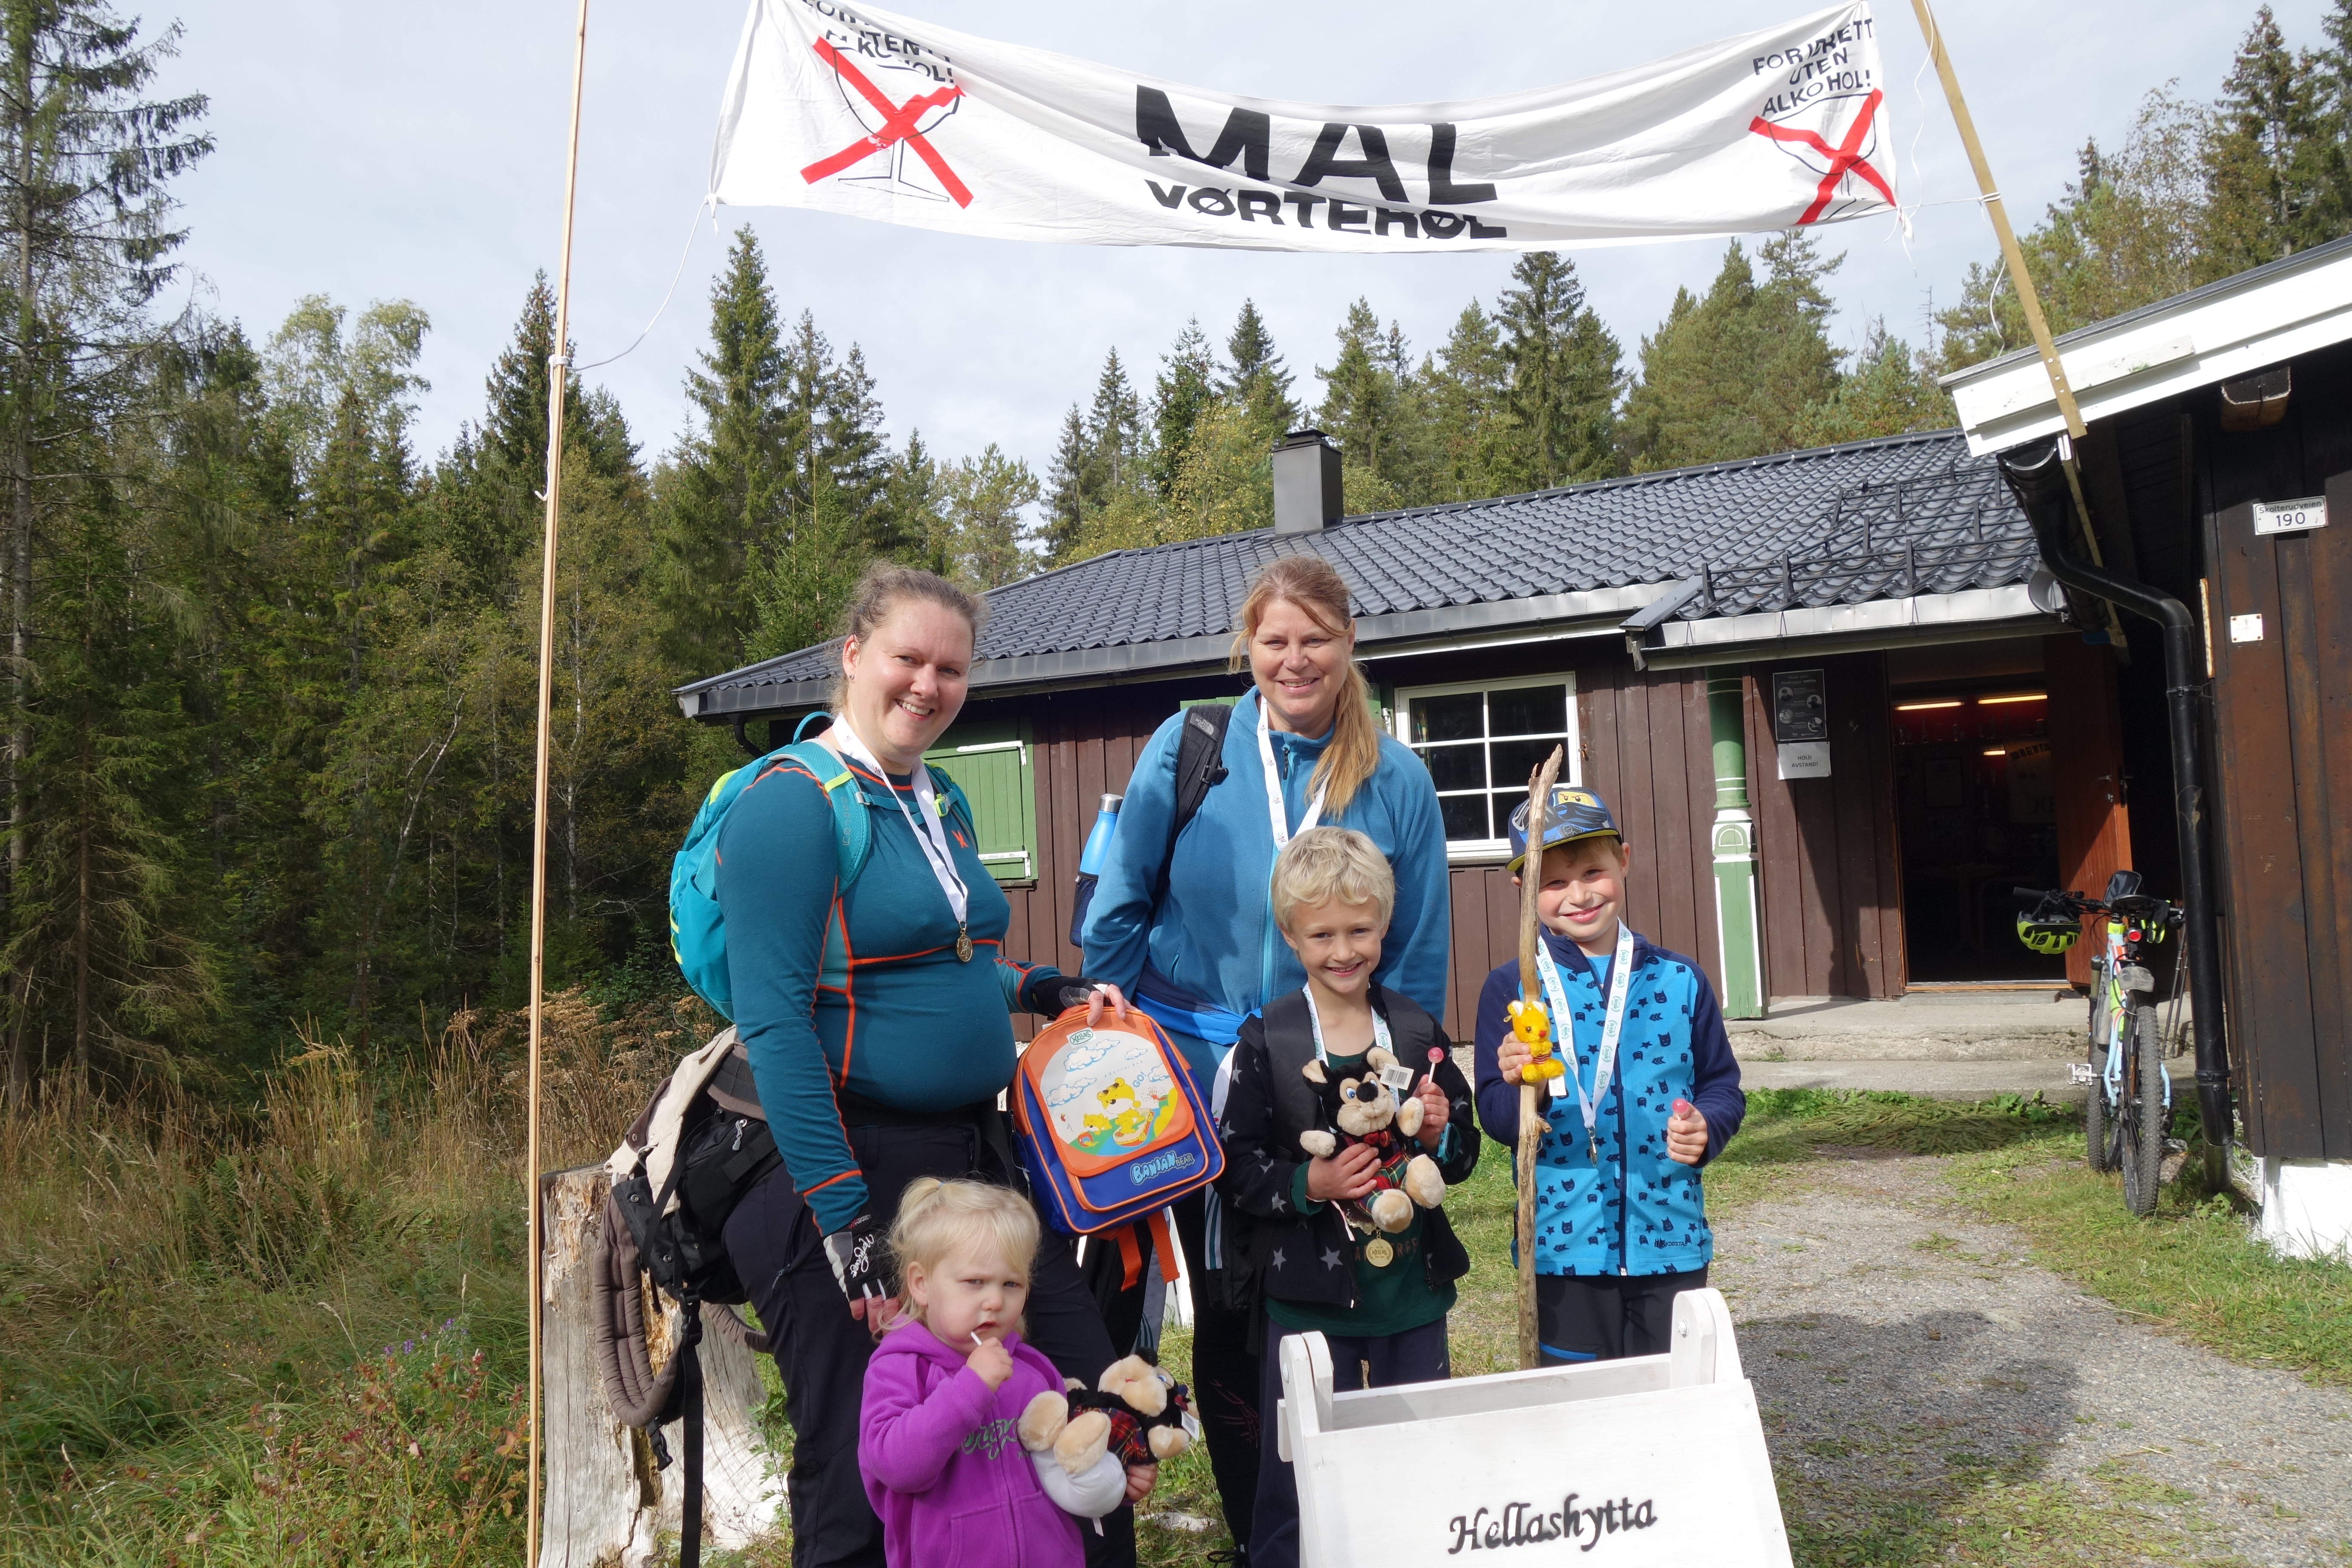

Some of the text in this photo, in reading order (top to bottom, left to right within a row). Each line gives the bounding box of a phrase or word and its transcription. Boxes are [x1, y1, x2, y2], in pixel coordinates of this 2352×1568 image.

[1753, 48, 1803, 75] FOR
[1789, 47, 1848, 85] UTEN
[1761, 70, 1871, 116] ALKOHOL!
[2259, 500, 2321, 514] Skolterudveien
[2276, 512, 2306, 527] 190
[1072, 1031, 1091, 1044] HELLAS
[1133, 1071, 1147, 1087] GO!
[1176, 1155, 1192, 1166] BEAR
[1448, 1493, 1658, 1555] Hellashytta
